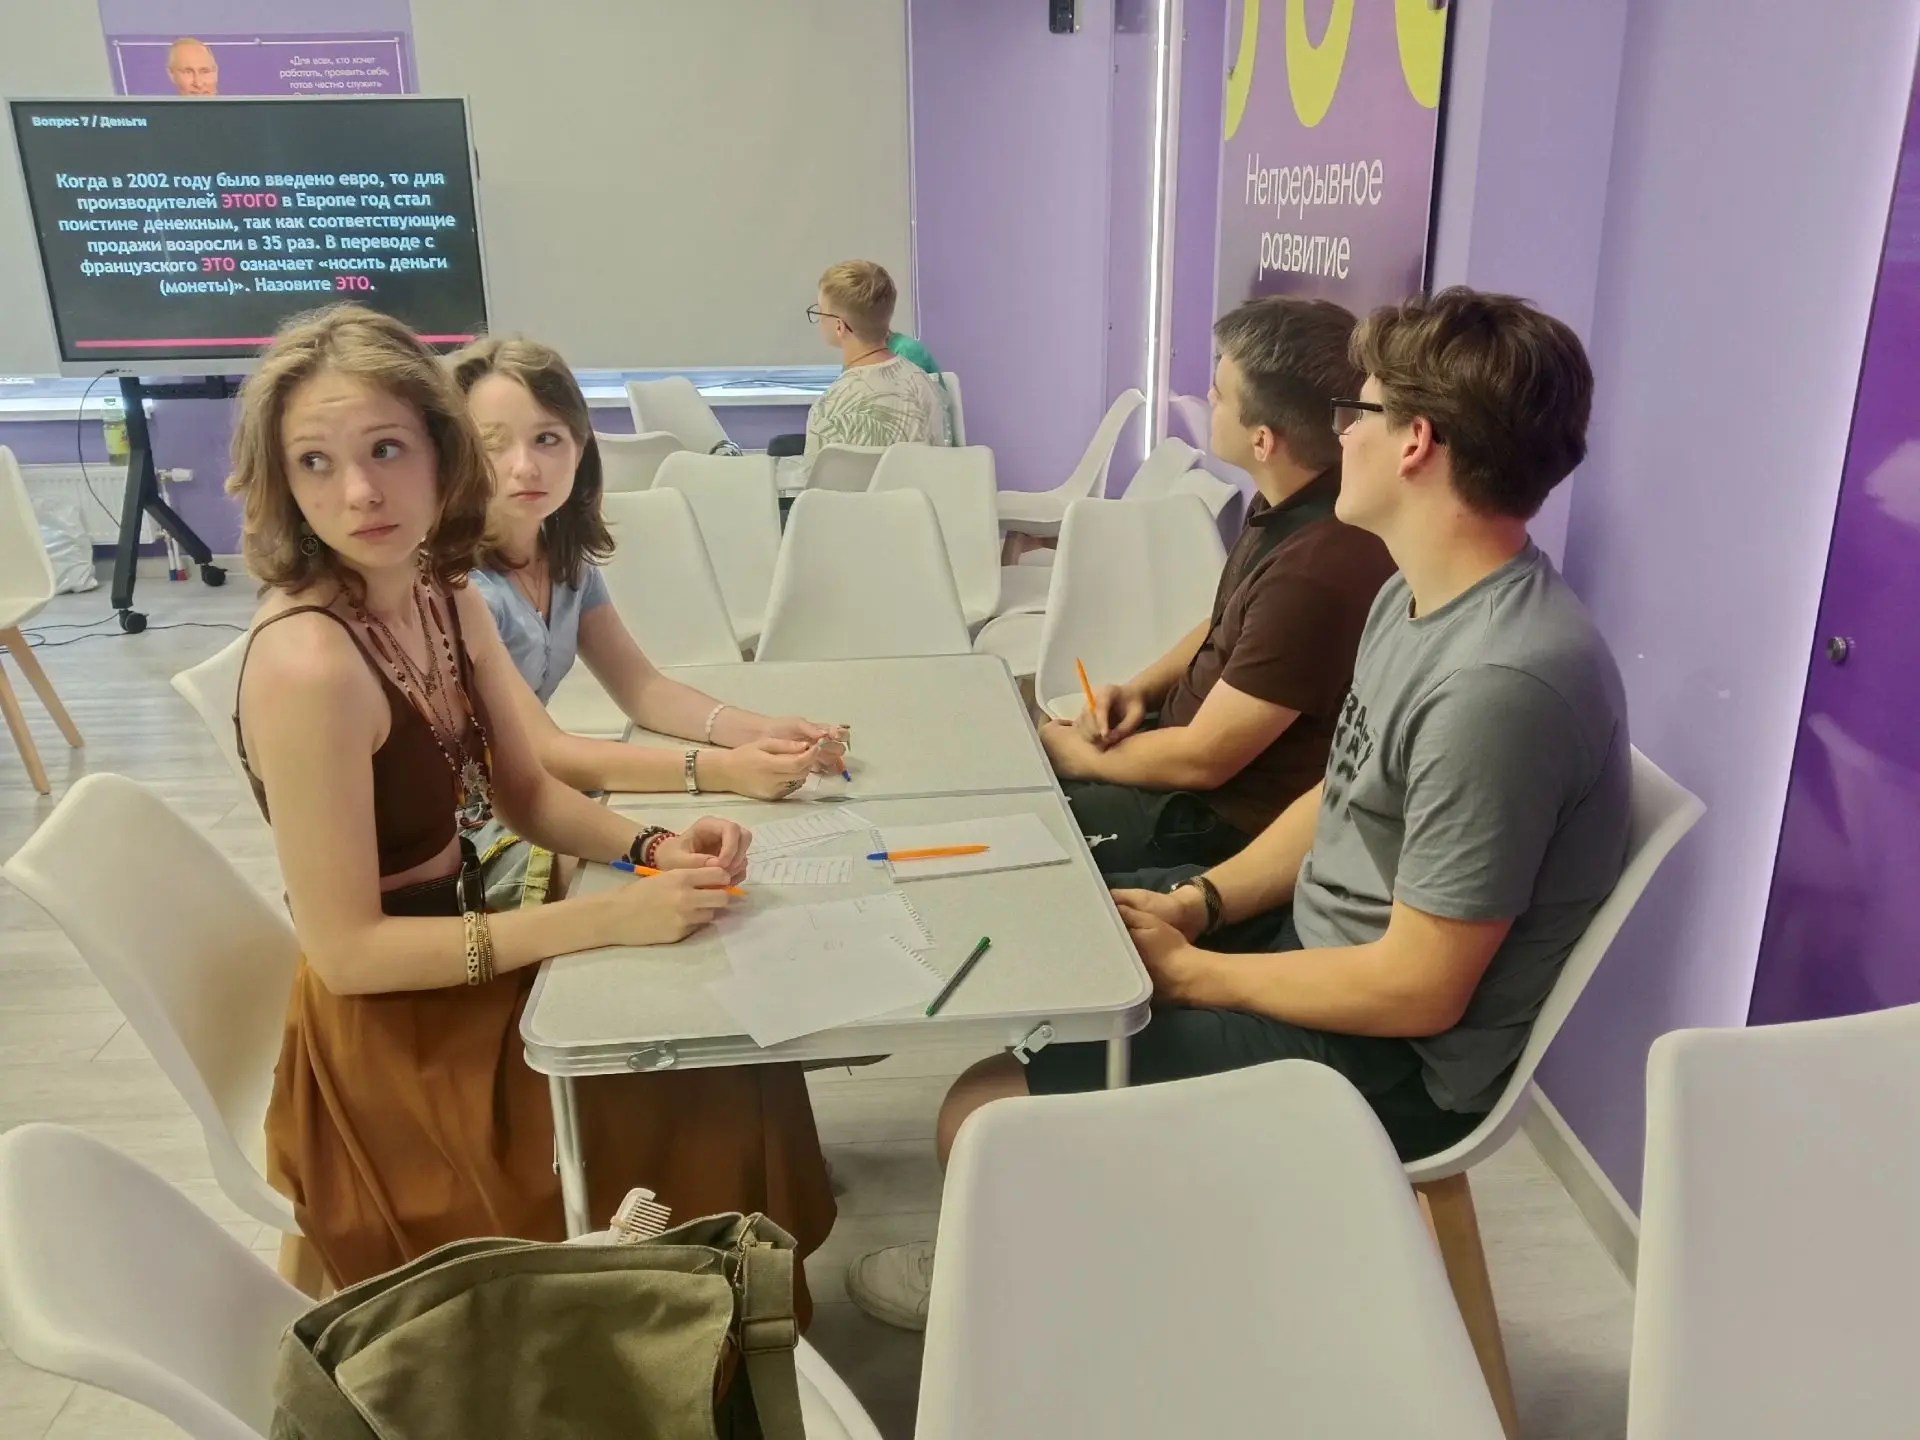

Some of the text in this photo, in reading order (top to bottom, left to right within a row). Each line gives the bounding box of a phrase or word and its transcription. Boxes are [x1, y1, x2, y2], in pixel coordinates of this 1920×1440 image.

[315, 81, 344, 89] честно
[32, 116, 79, 129] Вопрос
[82, 116, 88, 127] 7
[100, 116, 147, 128] Деньги
[56, 172, 444, 191] Когда в 2002 году было введено евро, то для
[1245, 152, 1384, 220] Непрерывное
[77, 192, 431, 213] производителей ЭТОГО в Европе год стал
[58, 214, 455, 233] поистине денежным, так как соответствующие
[87, 234, 434, 256] продажи возросли в 35 раз. В переводе с
[80, 256, 447, 276] французского ЭТО означает «носить деньги
[1259, 231, 1351, 281] развитие
[159, 275, 375, 296] (монеты)». Назовите ЭТО.
